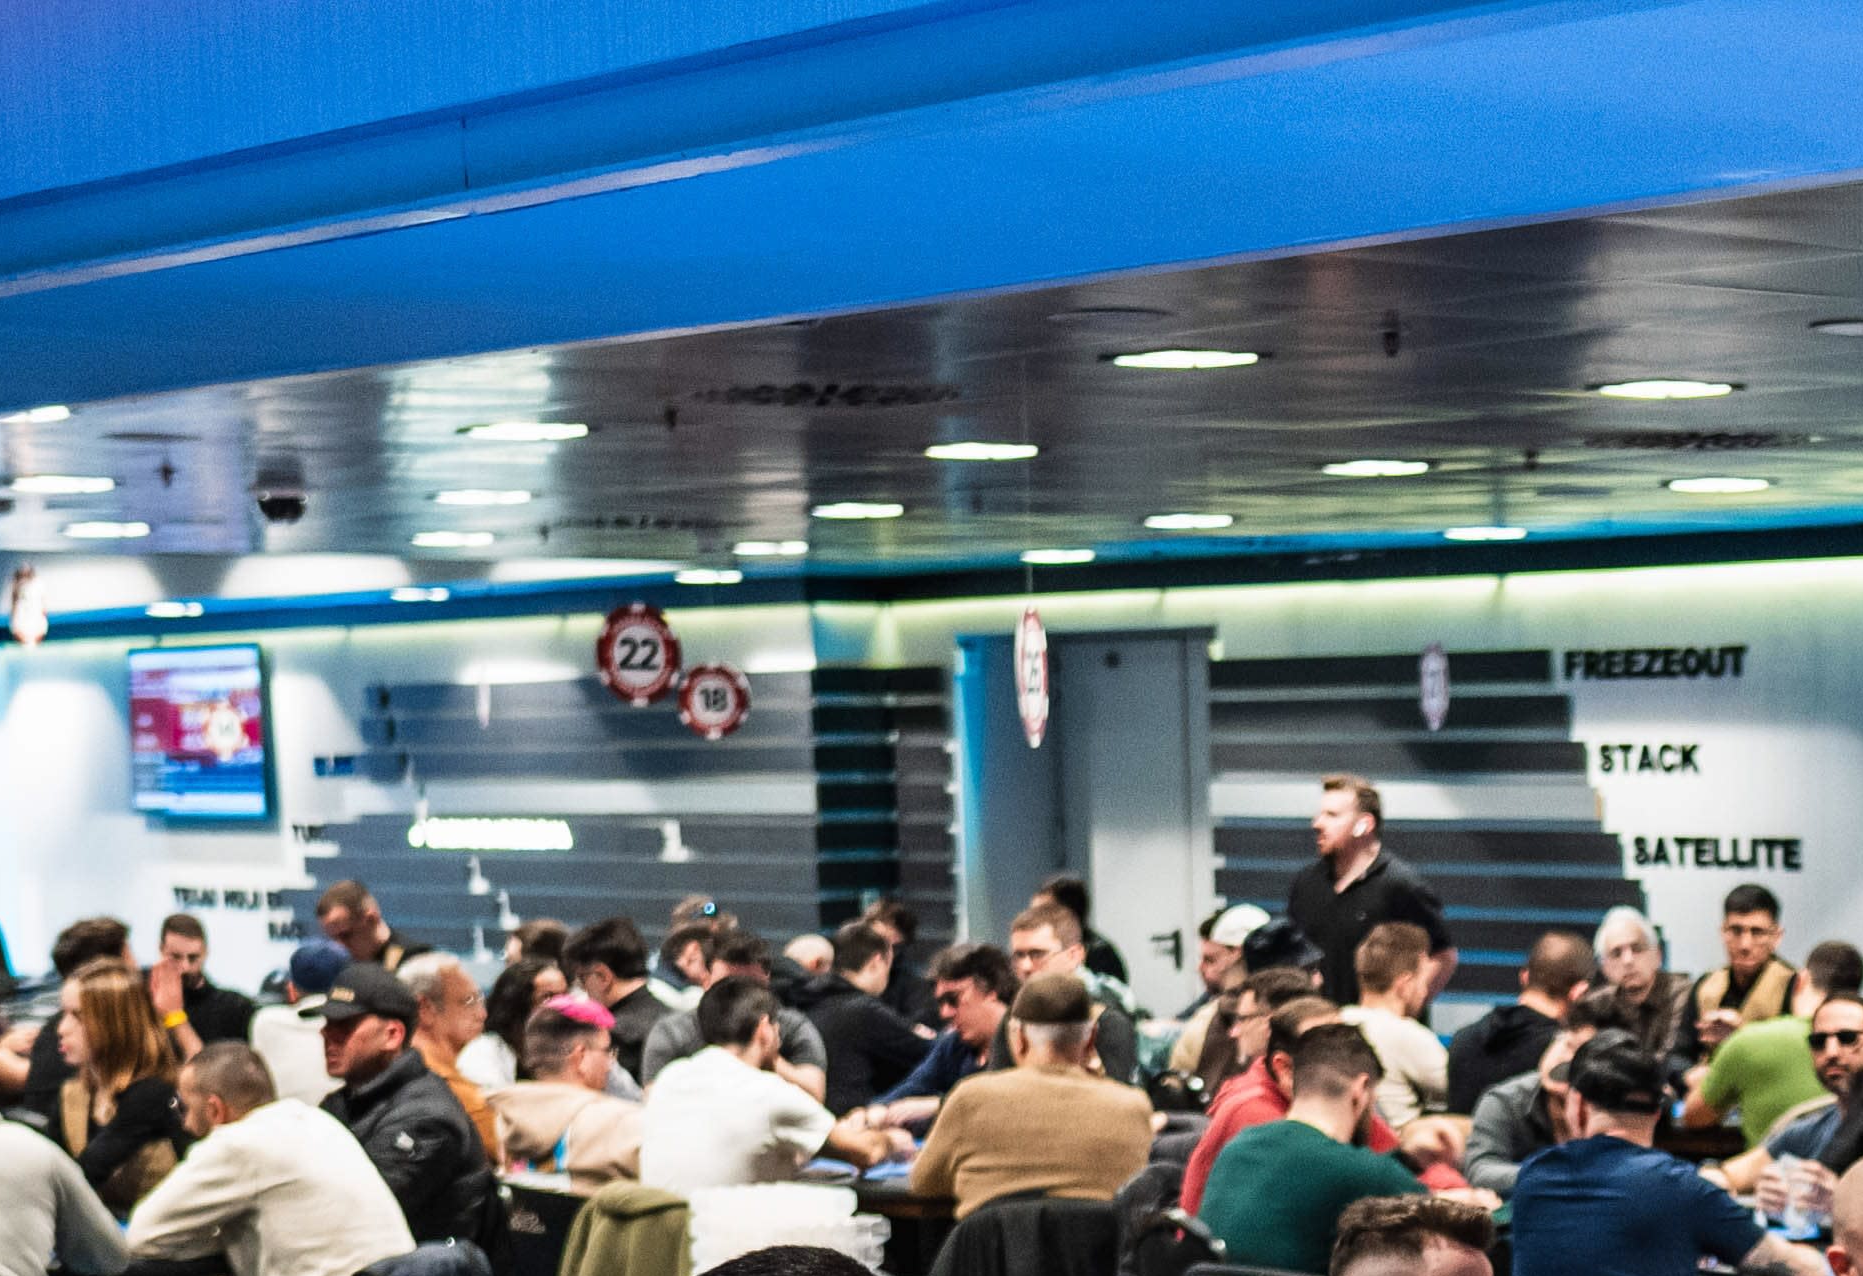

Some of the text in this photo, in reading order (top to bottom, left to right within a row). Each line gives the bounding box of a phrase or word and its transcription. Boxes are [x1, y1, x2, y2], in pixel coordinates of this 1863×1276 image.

[618, 636, 660, 671] 22
[1564, 645, 1749, 681] FREEZEOUT
[1599, 743, 1701, 774] STACK
[1634, 836, 1803, 871] SATELLITE
